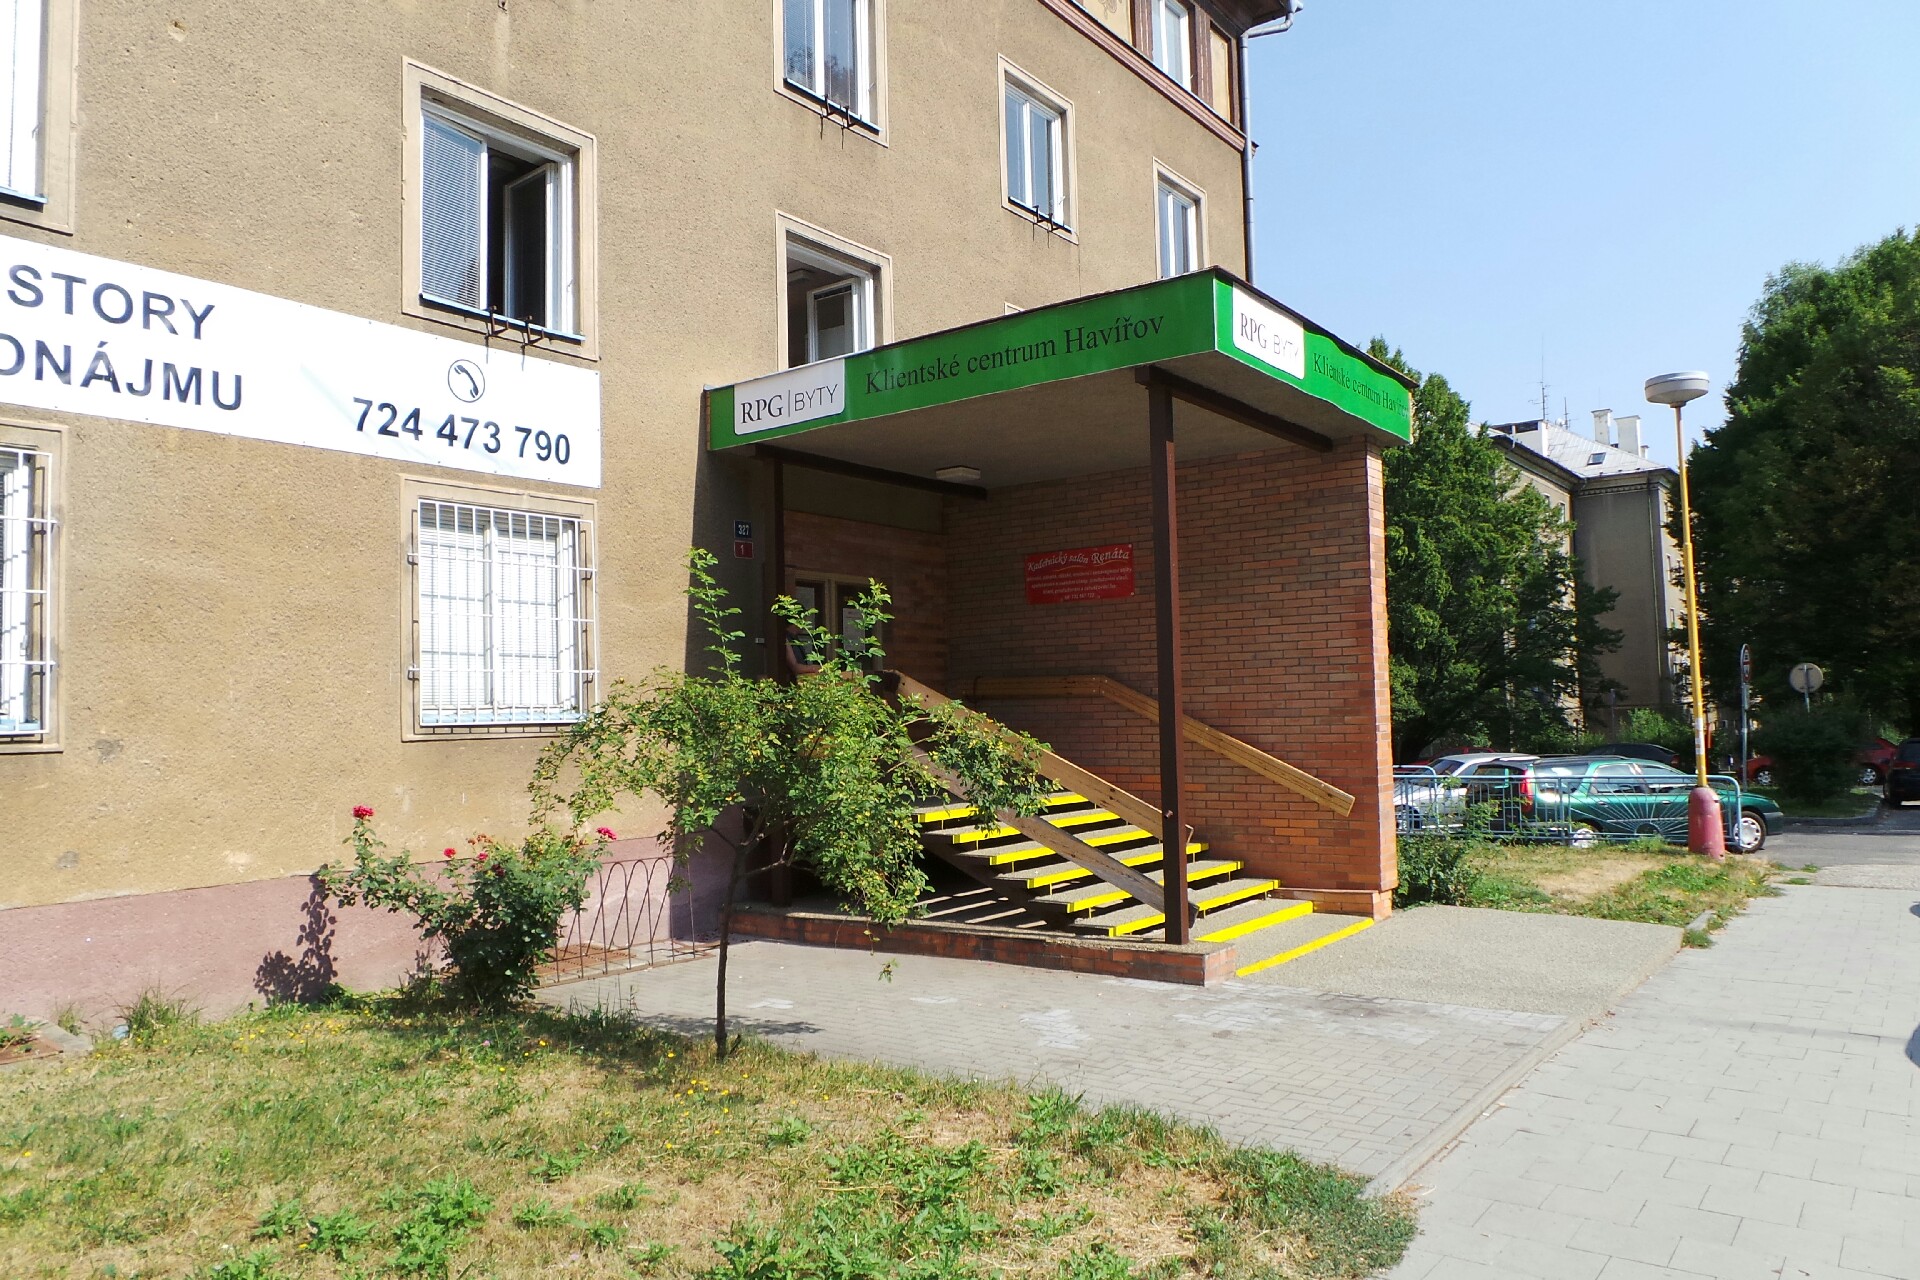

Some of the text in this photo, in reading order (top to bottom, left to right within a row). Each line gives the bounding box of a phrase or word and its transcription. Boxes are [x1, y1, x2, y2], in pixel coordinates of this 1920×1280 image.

[7, 264, 215, 340] STORY
[1240, 312, 1267, 349] RPG
[865, 315, 1164, 394] Klientské centrum Havířov
[740, 384, 839, 424] RPG BYTY
[353, 397, 571, 465] 724 473 790
[738, 524, 750, 536] 327
[740, 544, 744, 555] 1
[1091, 547, 1130, 565] Renáta
